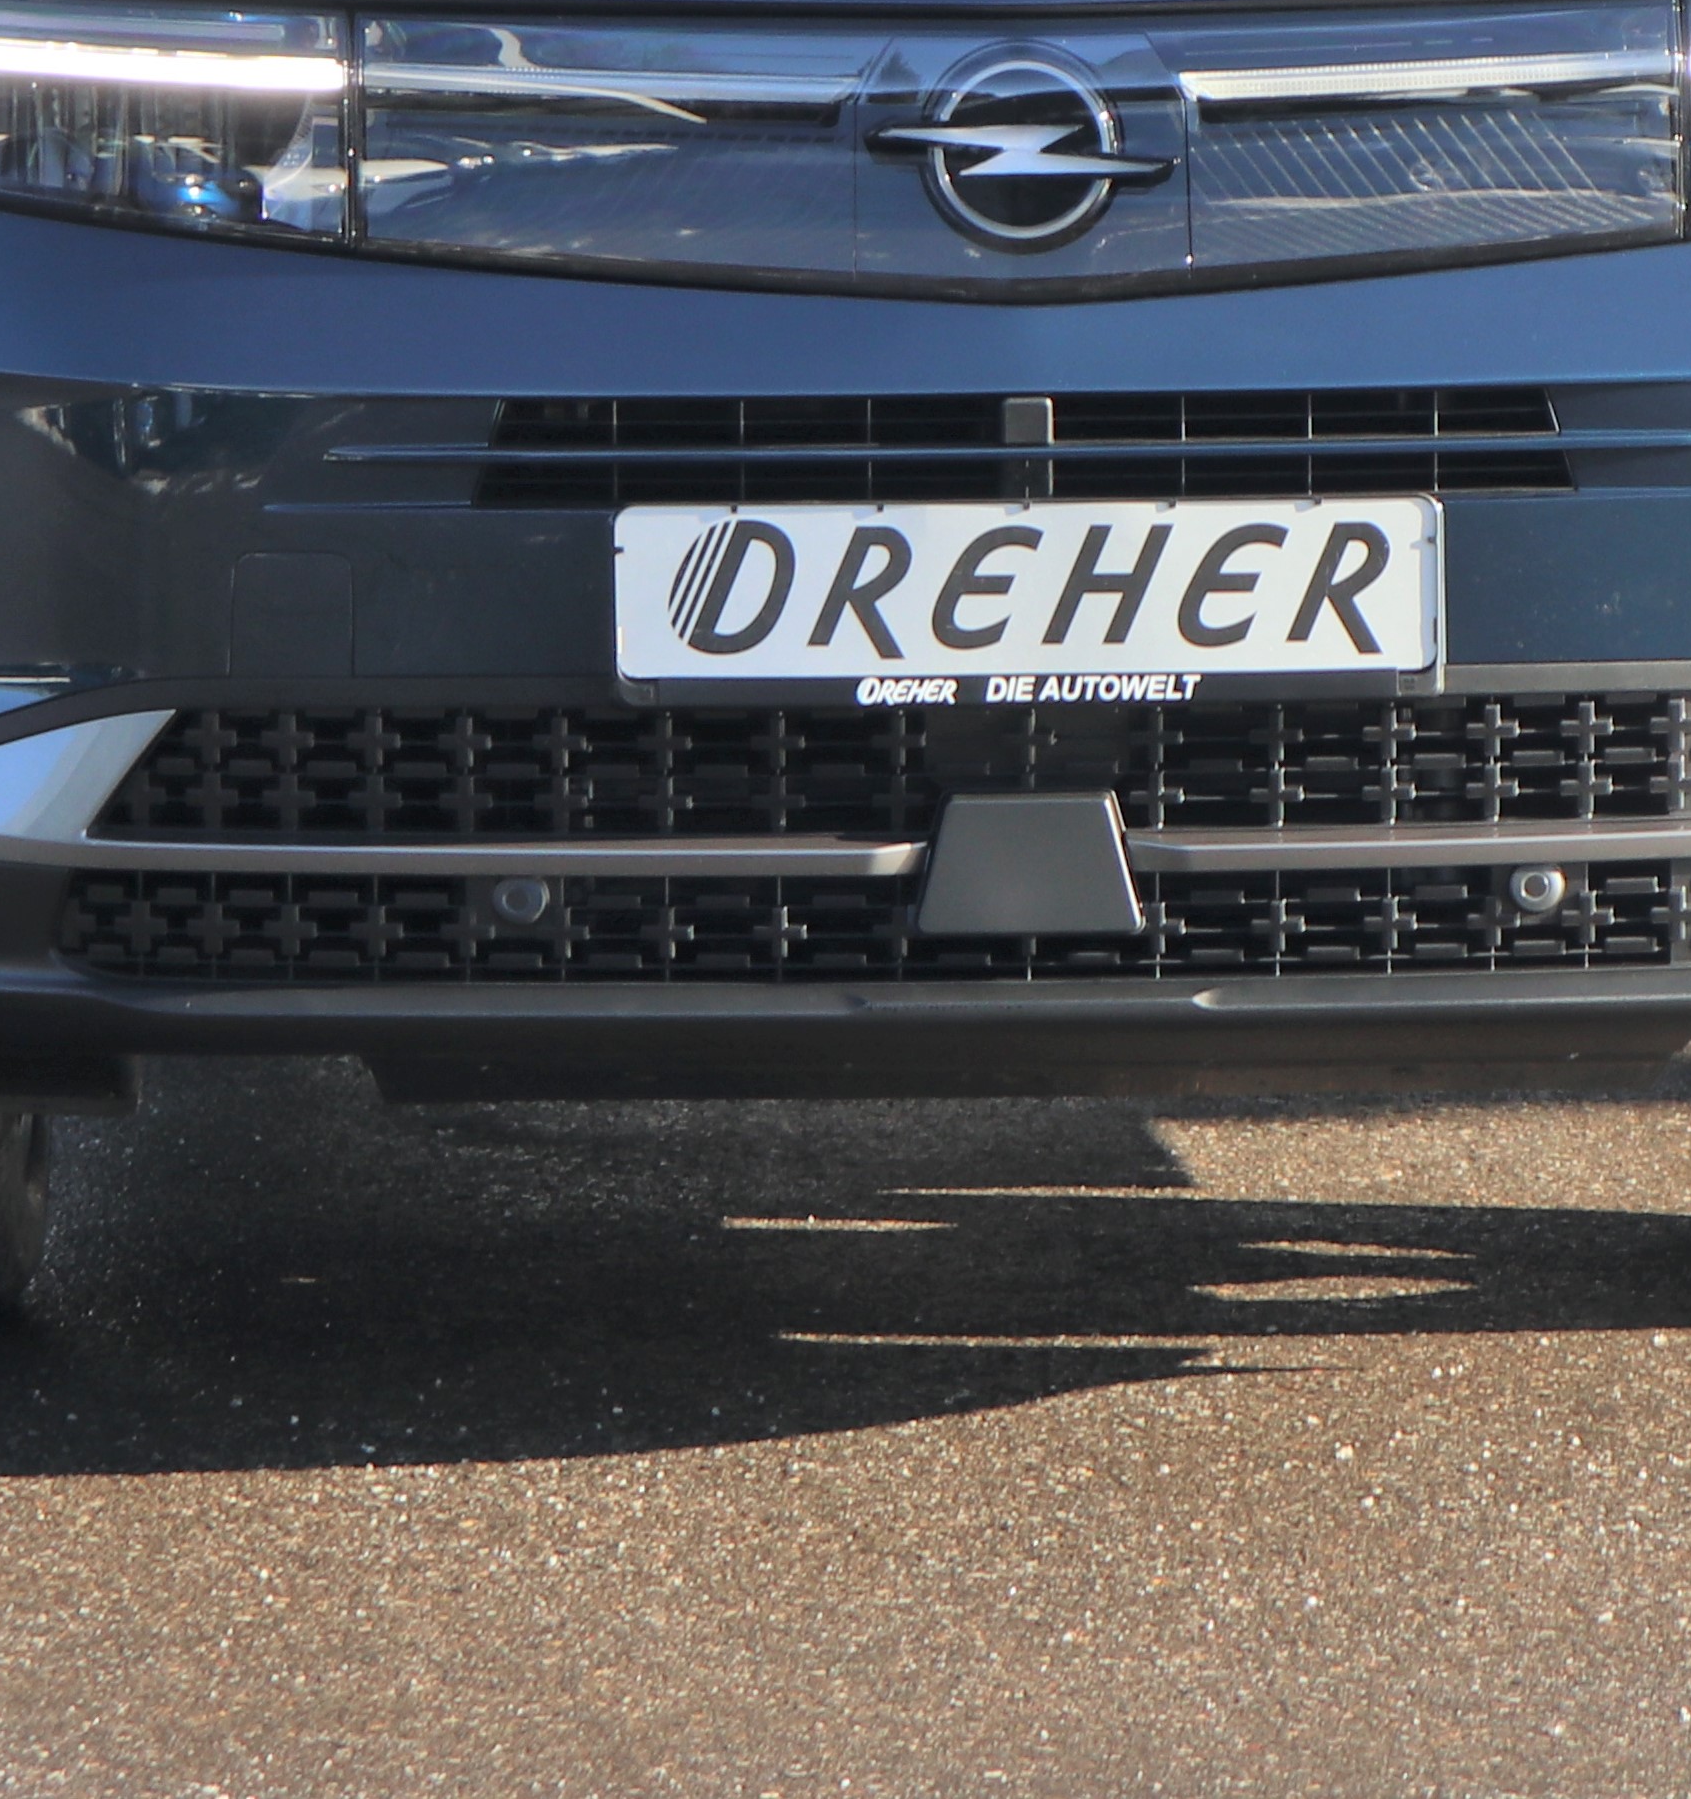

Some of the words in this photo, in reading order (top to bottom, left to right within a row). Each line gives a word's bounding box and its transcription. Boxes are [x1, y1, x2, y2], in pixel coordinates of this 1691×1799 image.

[668, 519, 1391, 659] DREHER
[856, 676, 958, 706] DREHER
[985, 676, 1036, 703] DIE
[1039, 673, 1201, 703] AUTOWELT
